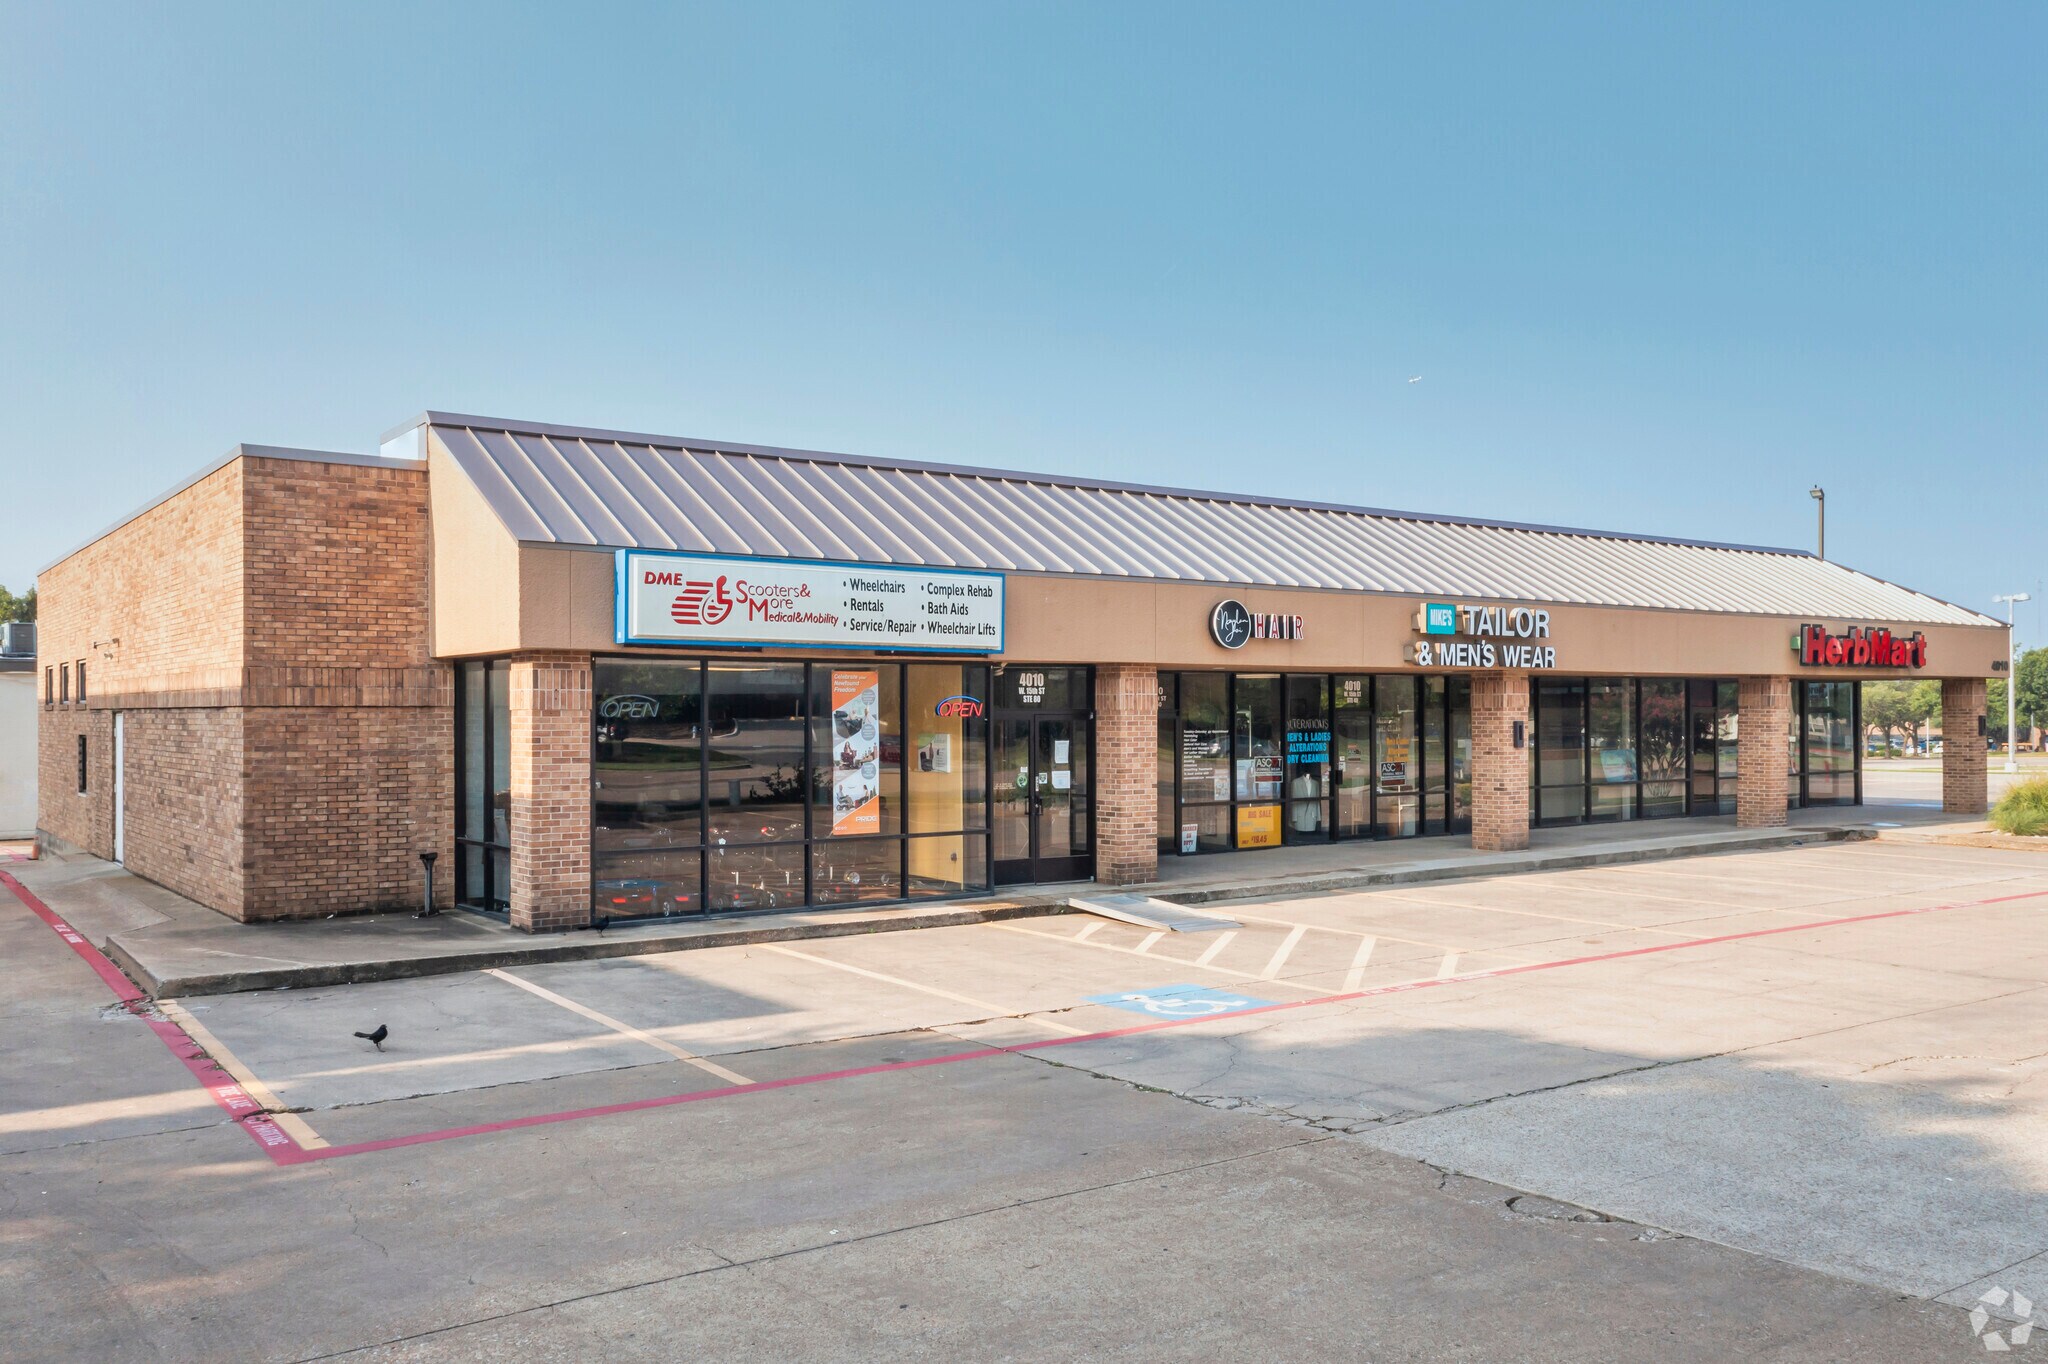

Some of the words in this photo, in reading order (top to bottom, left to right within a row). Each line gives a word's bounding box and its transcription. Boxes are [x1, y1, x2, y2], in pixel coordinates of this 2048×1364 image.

[644, 571, 683, 586] DME
[850, 578, 906, 593] Wheelchairs
[927, 582, 965, 599] Complex
[967, 585, 993, 597] Rehab
[851, 598, 884, 612] Rentals
[928, 602, 948, 615] Bath
[950, 603, 969, 615] Aids
[850, 619, 917, 636] Service/Repair
[928, 621, 975, 635] Wheelchair
[978, 623, 996, 636] Lifts
[1255, 613, 1304, 640] HAIR
[1464, 605, 1550, 639] TAILOR
[1419, 641, 1433, 666] &
[1440, 640, 1496, 668] MEN'S
[1503, 645, 1556, 669] WEAR
[1805, 626, 1928, 668] HerbMart
[1019, 672, 1044, 687] 4010
[1344, 680, 1361, 691] 4010
[1038, 687, 1045, 695] ST
[1023, 695, 1033, 703] STE
[604, 701, 660, 717] OPEN
[940, 702, 983, 717] OPEN
[1310, 732, 1331, 741] LADIES
[1289, 742, 1327, 752] ALTERATIONS
[1287, 754, 1299, 764] DRY
[1300, 753, 1329, 764] CLEANING
[1258, 809, 1272, 818] SALE
